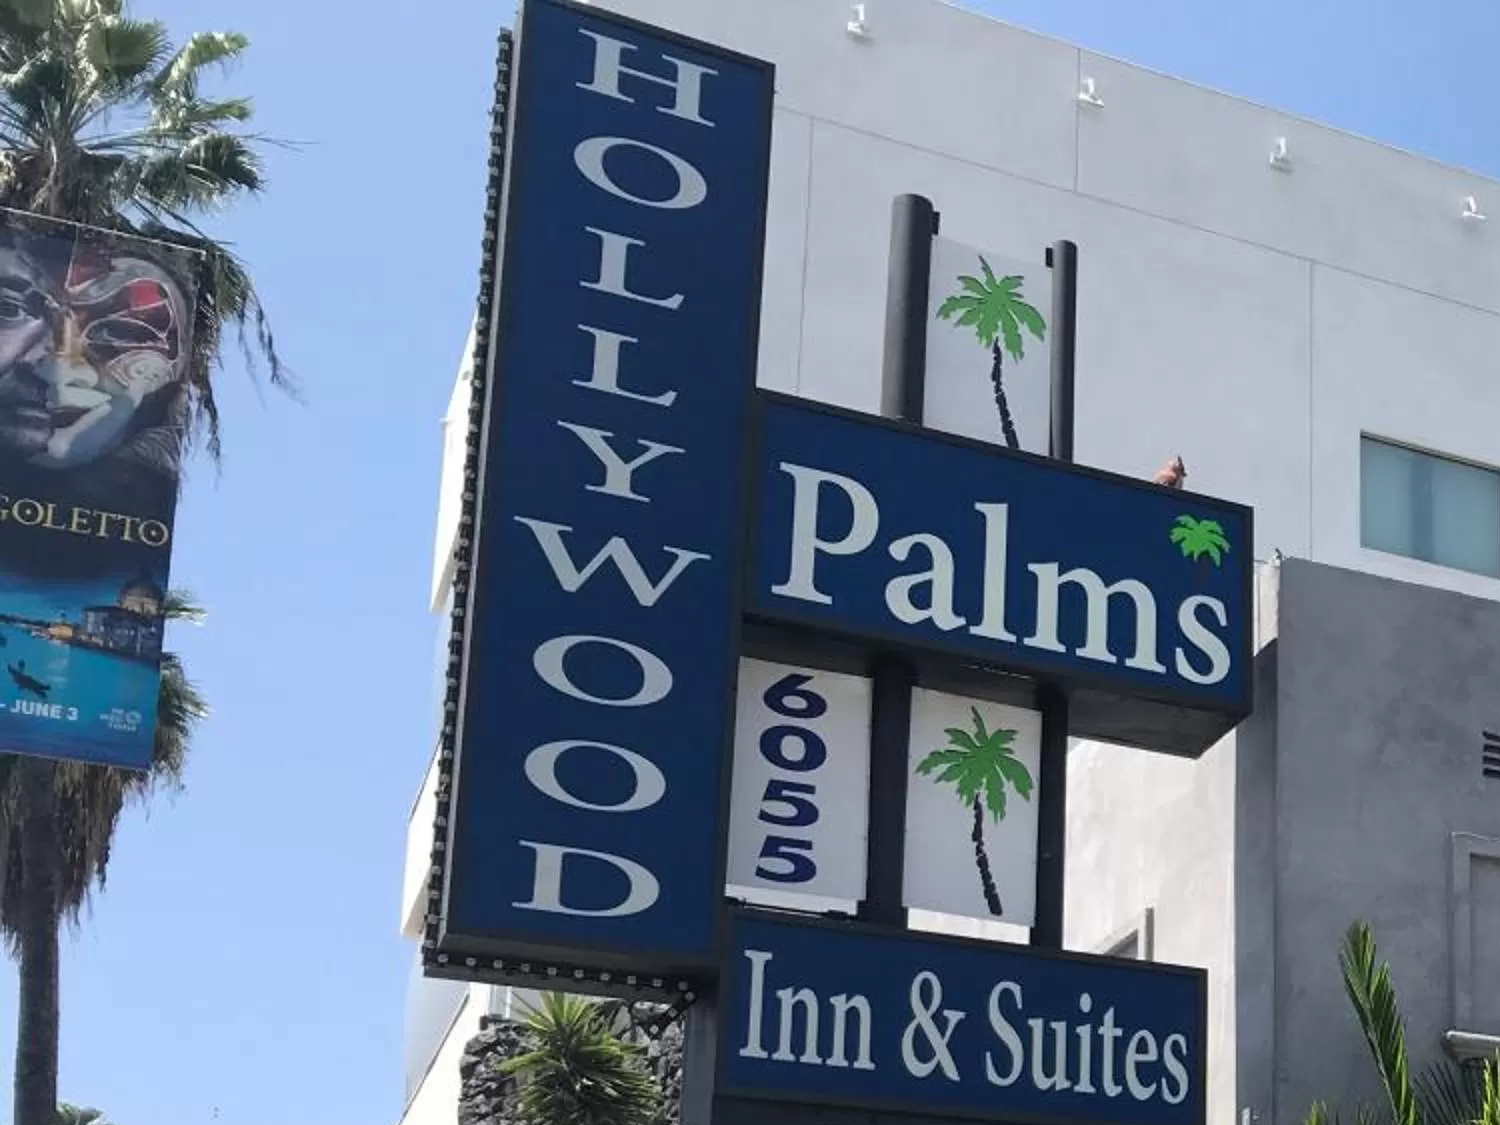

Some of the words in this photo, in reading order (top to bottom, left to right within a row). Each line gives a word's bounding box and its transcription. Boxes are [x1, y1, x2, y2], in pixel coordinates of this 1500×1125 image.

[512, 28, 718, 917] HOLLYWOOD
[771, 462, 1231, 686] Palms
[66, 707, 79, 721] 3
[755, 673, 827, 883] 6055
[739, 949, 875, 1071] Inn
[901, 970, 966, 1082] &
[986, 980, 1189, 1105] Suites
